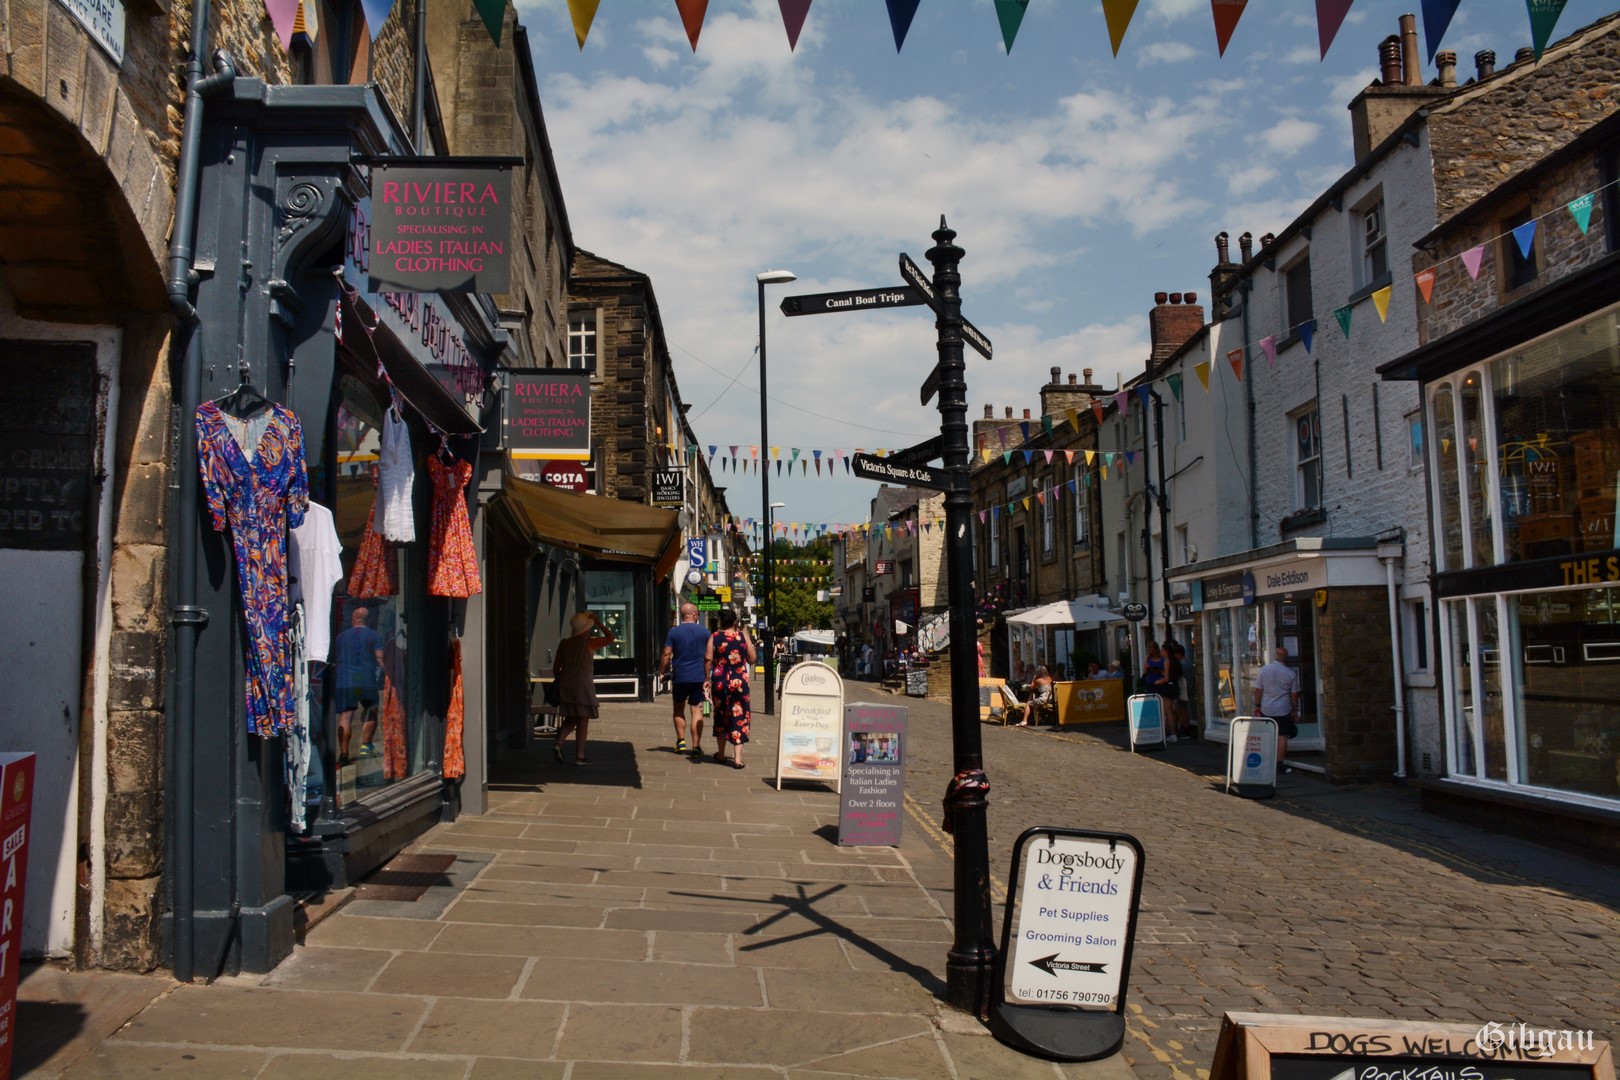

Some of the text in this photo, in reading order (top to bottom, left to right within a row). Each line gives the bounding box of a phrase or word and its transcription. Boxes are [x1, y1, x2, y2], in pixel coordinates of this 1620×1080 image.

[101, 27, 122, 58] CANAL
[383, 181, 499, 204] RIVIERA
[395, 206, 487, 217] BOUTIQUE
[397, 225, 484, 235] SPECIALISING IN
[376, 240, 504, 255] LADIES ITALIAN
[395, 257, 483, 272] CLOTHING
[826, 292, 905, 308] Canal Boat Trips
[515, 383, 583, 397] RIVIERA
[521, 397, 576, 405] BOUTIQUE
[511, 418, 586, 427] LADIES ITALIAN
[522, 428, 574, 437] CLOTHING
[860, 459, 931, 482] Victoria Square & Cafe
[545, 473, 584, 484] COSTA
[656, 473, 680, 487] IWJ
[690, 546, 705, 567] S
[1560, 558, 1601, 585] THE
[1267, 571, 1308, 588] Dale Eddison
[792, 705, 832, 716] Breakfast
[848, 767, 900, 777] Specialising in
[850, 777, 897, 786] Italian Ladies
[859, 787, 887, 795] Fashion
[848, 799, 896, 808] Over 2 floors
[5, 829, 23, 855] SALE
[1036, 849, 1126, 875] Dogsbody
[1037, 873, 1118, 896] & Friends
[1039, 907, 1109, 923] Pet Supplies
[1026, 930, 1117, 947] Grooming Salon
[1046, 961, 1091, 971] Victoria Street
[1018, 988, 1110, 1003] tel: 01756 790790
[1304, 1031, 1393, 1056] DOGS
